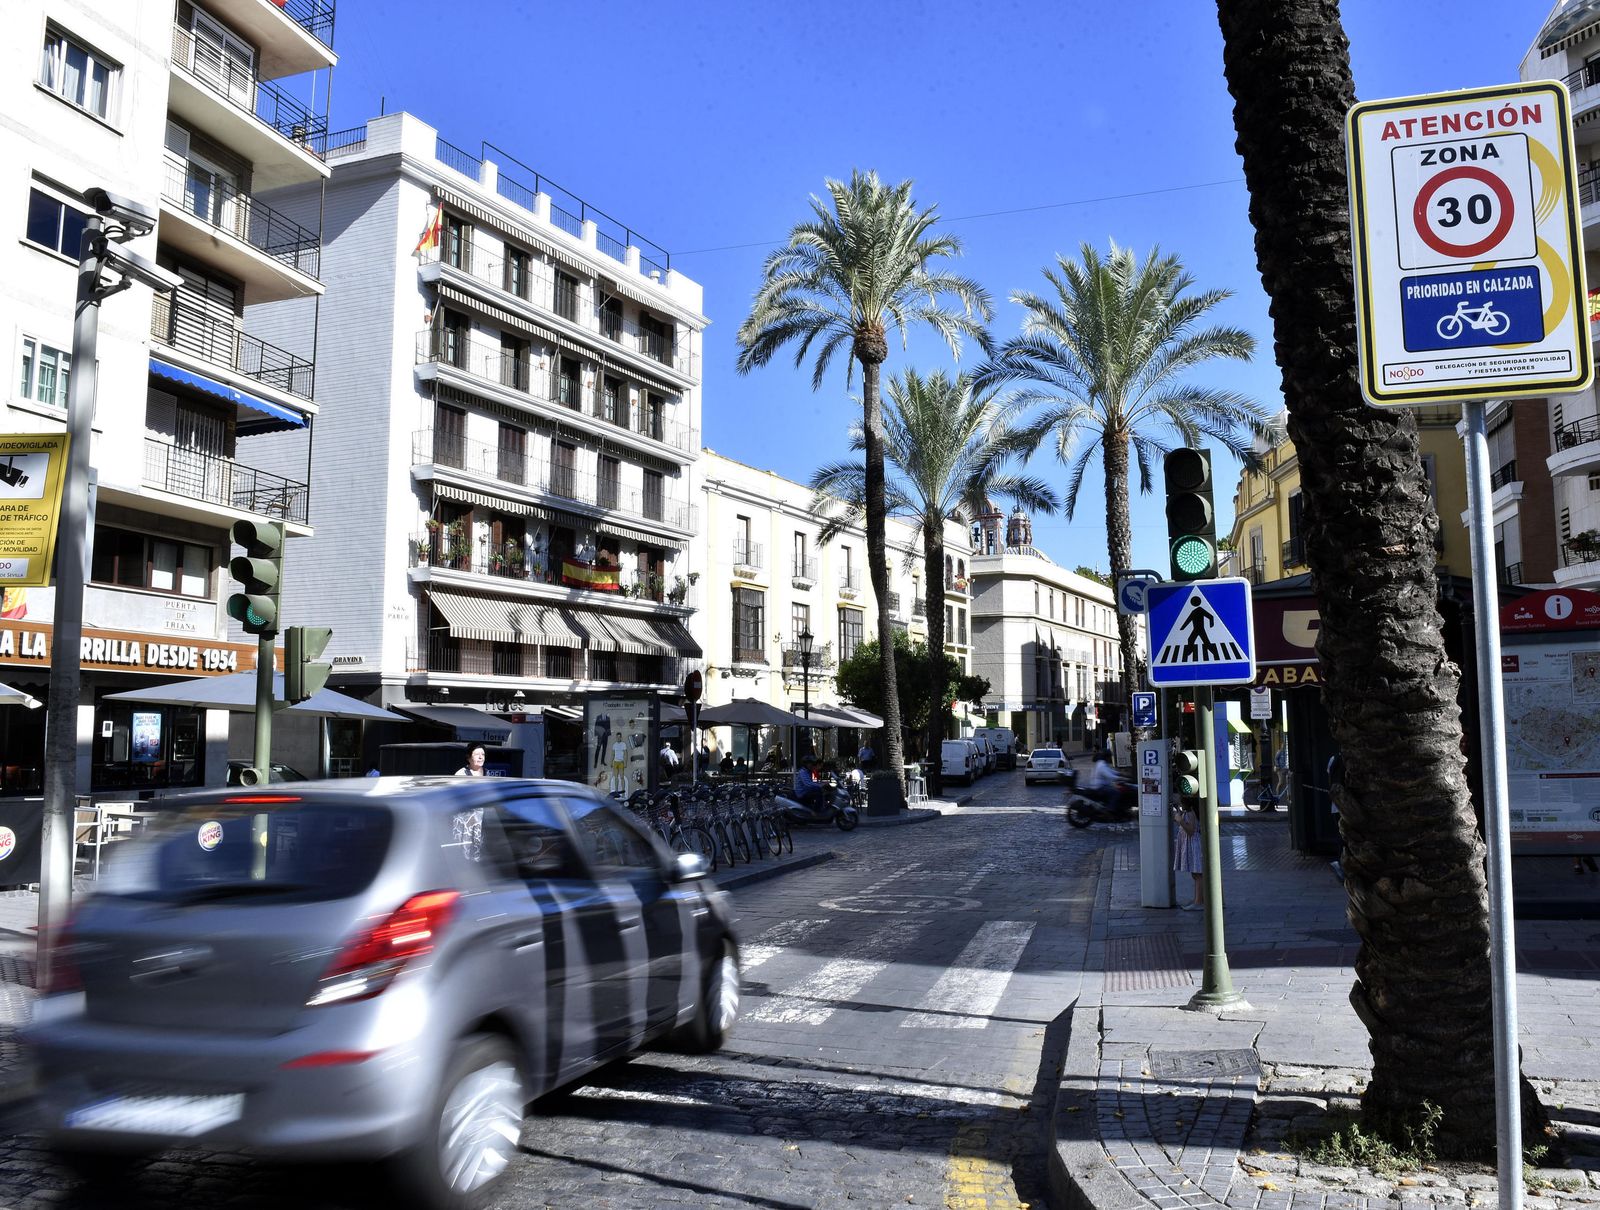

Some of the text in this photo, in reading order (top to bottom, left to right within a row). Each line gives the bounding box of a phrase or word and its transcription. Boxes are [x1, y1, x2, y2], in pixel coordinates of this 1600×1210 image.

[1381, 102, 1542, 141] ATENCIÓN
[1420, 143, 1499, 166] ZONA
[1437, 194, 1492, 228] 30
[1407, 276, 1534, 299] PRIORIDAD EN CALZADA
[1435, 362, 1477, 370] DELEGACIÓN
[1489, 358, 1528, 366] SEGURIDAD
[1529, 355, 1566, 363] MOVILIDAD
[17, 504, 29, 512] DE
[13, 513, 49, 521] TRÁFICO
[165, 601, 197, 610] PUERTA
[166, 621, 196, 630] TRIANA
[21, 631, 47, 657] LA
[146, 643, 198, 668] DESDE
[202, 648, 238, 671] 1954
[1252, 666, 1326, 685] TABA
[1140, 698, 1149, 710] P
[202, 831, 220, 843] KING
